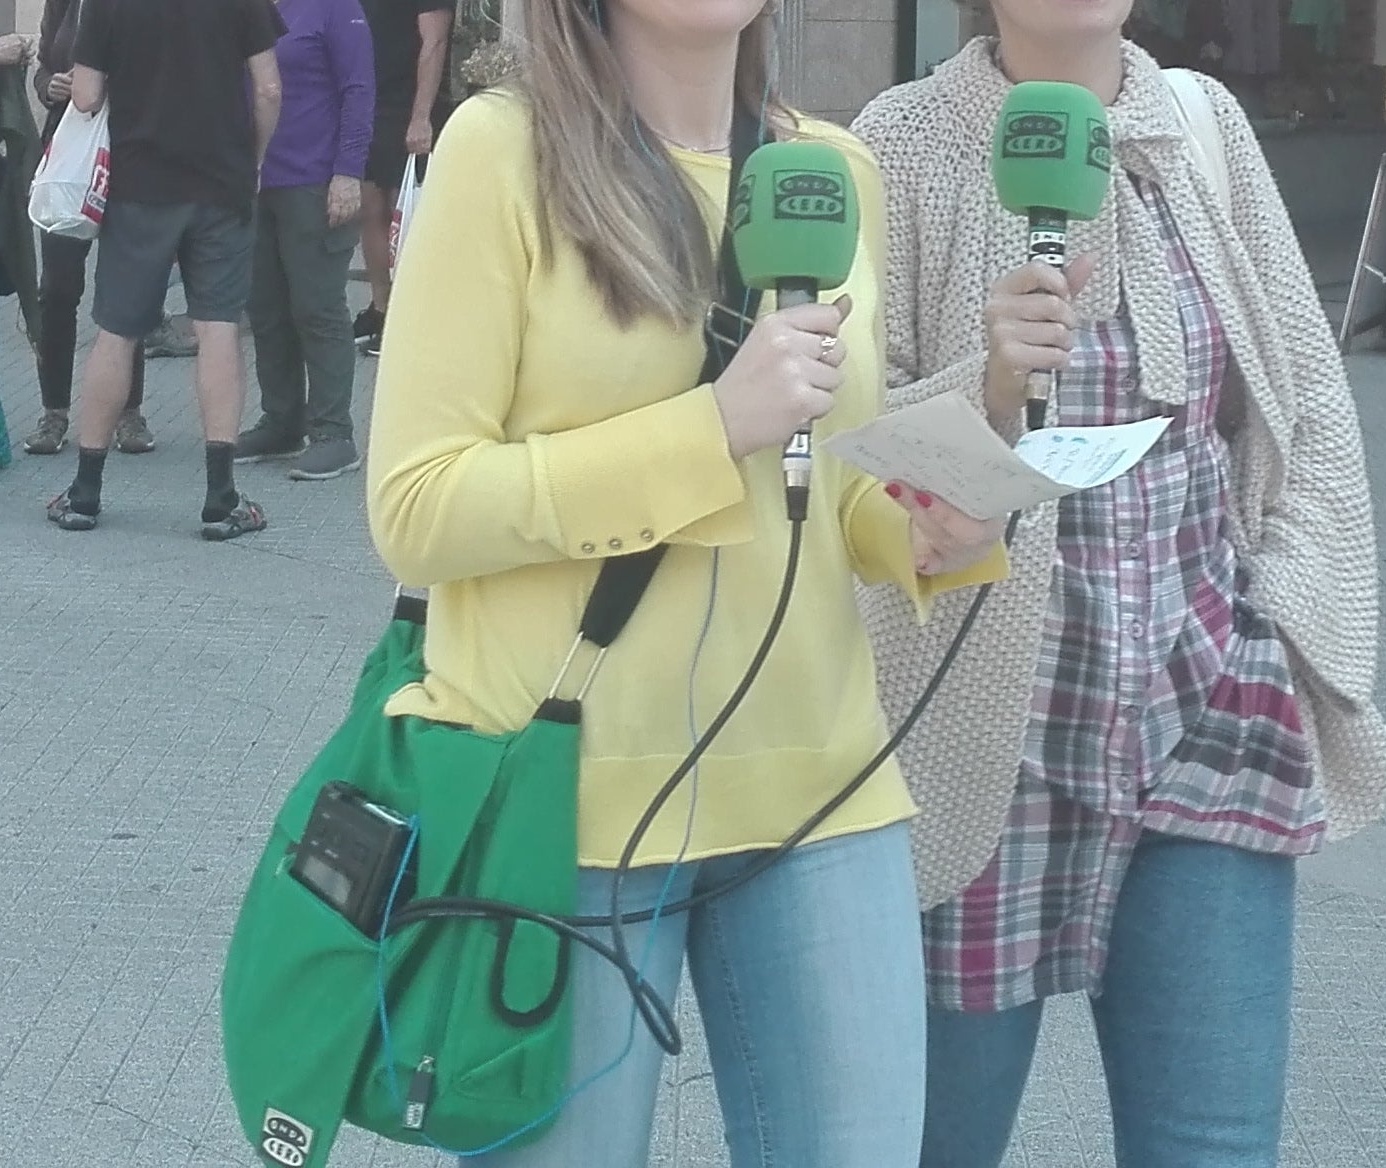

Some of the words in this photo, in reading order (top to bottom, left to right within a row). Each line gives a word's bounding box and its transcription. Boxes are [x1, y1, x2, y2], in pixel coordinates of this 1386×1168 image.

[1012, 138, 1056, 150] CERO
[784, 179, 835, 189] ONDA
[787, 198, 837, 212] CERO
[270, 1119, 305, 1144] ONDA
[268, 1139, 300, 1164] CERO
